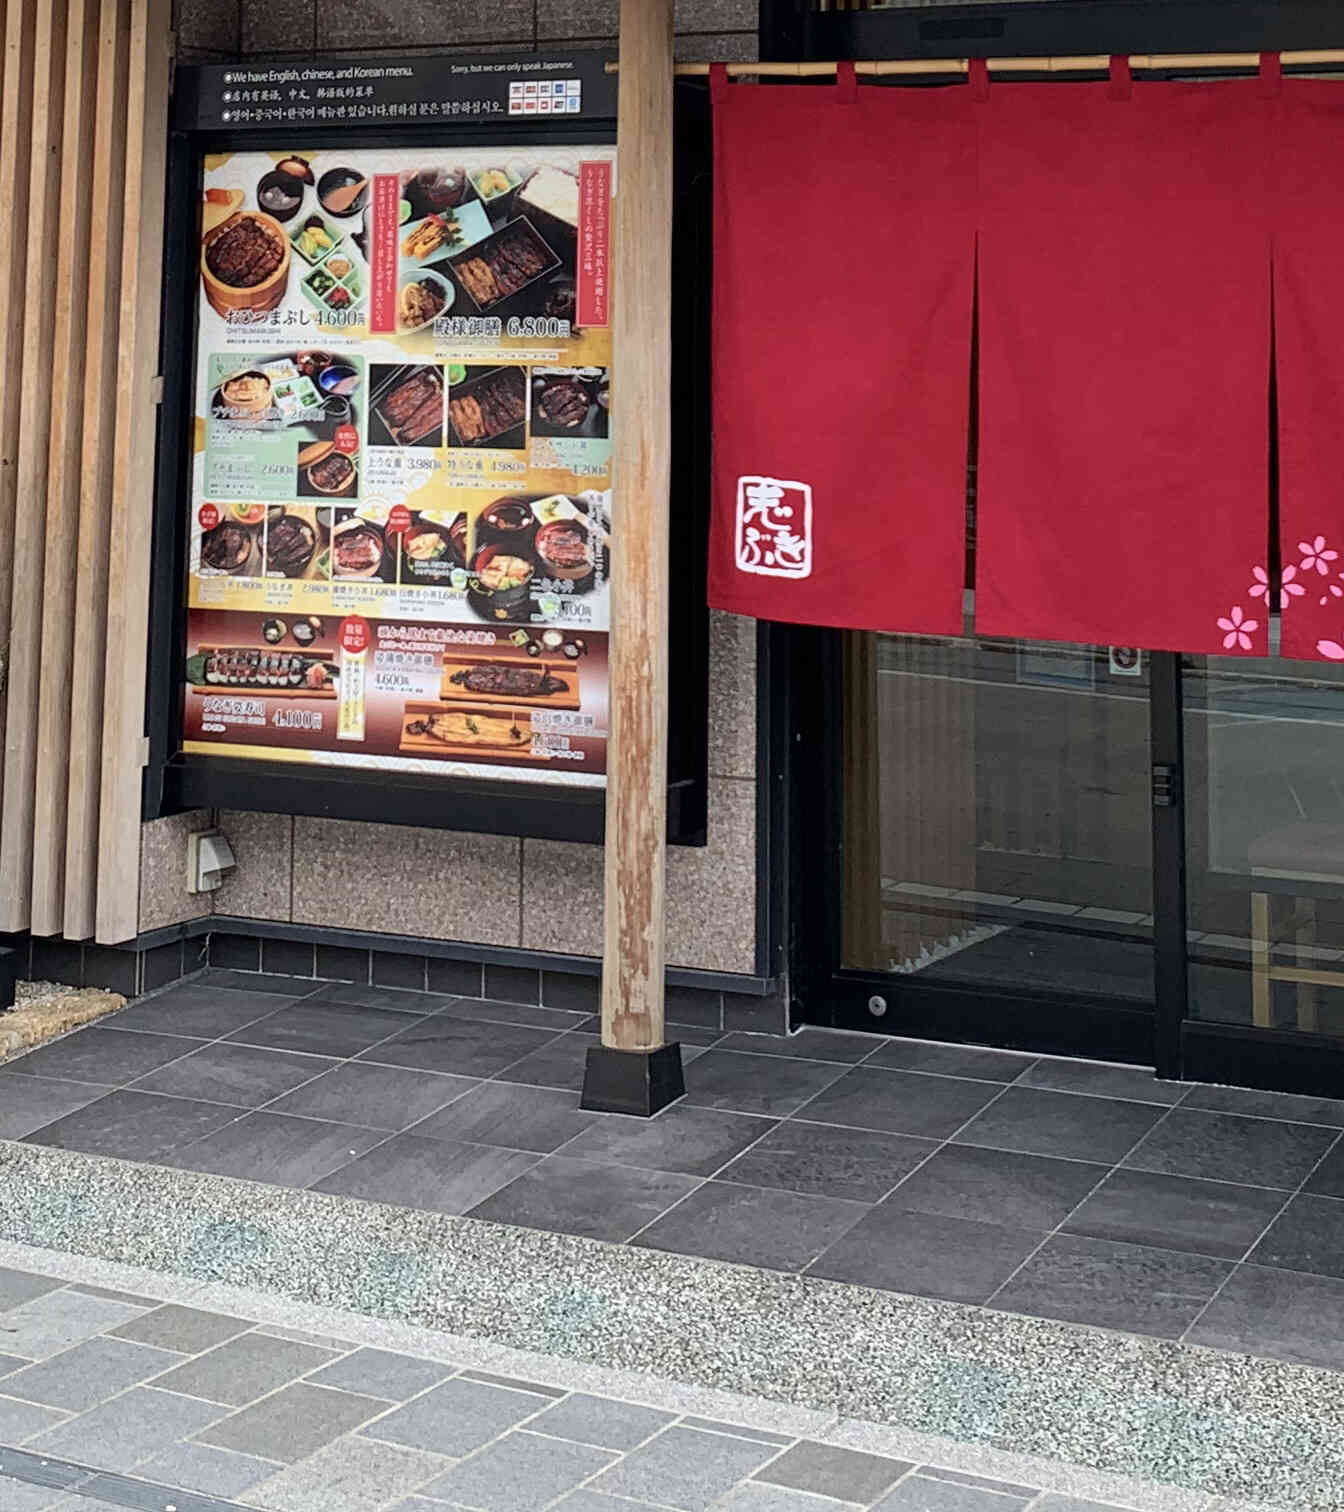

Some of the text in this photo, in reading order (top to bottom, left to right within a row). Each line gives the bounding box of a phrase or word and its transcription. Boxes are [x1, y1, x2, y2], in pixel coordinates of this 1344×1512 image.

[233, 72, 247, 83] We
[248, 71, 268, 83] have
[269, 69, 301, 84] English,
[336, 67, 353, 79] and
[354, 66, 385, 79] Korean
[225, 310, 309, 326] おひつまぶし
